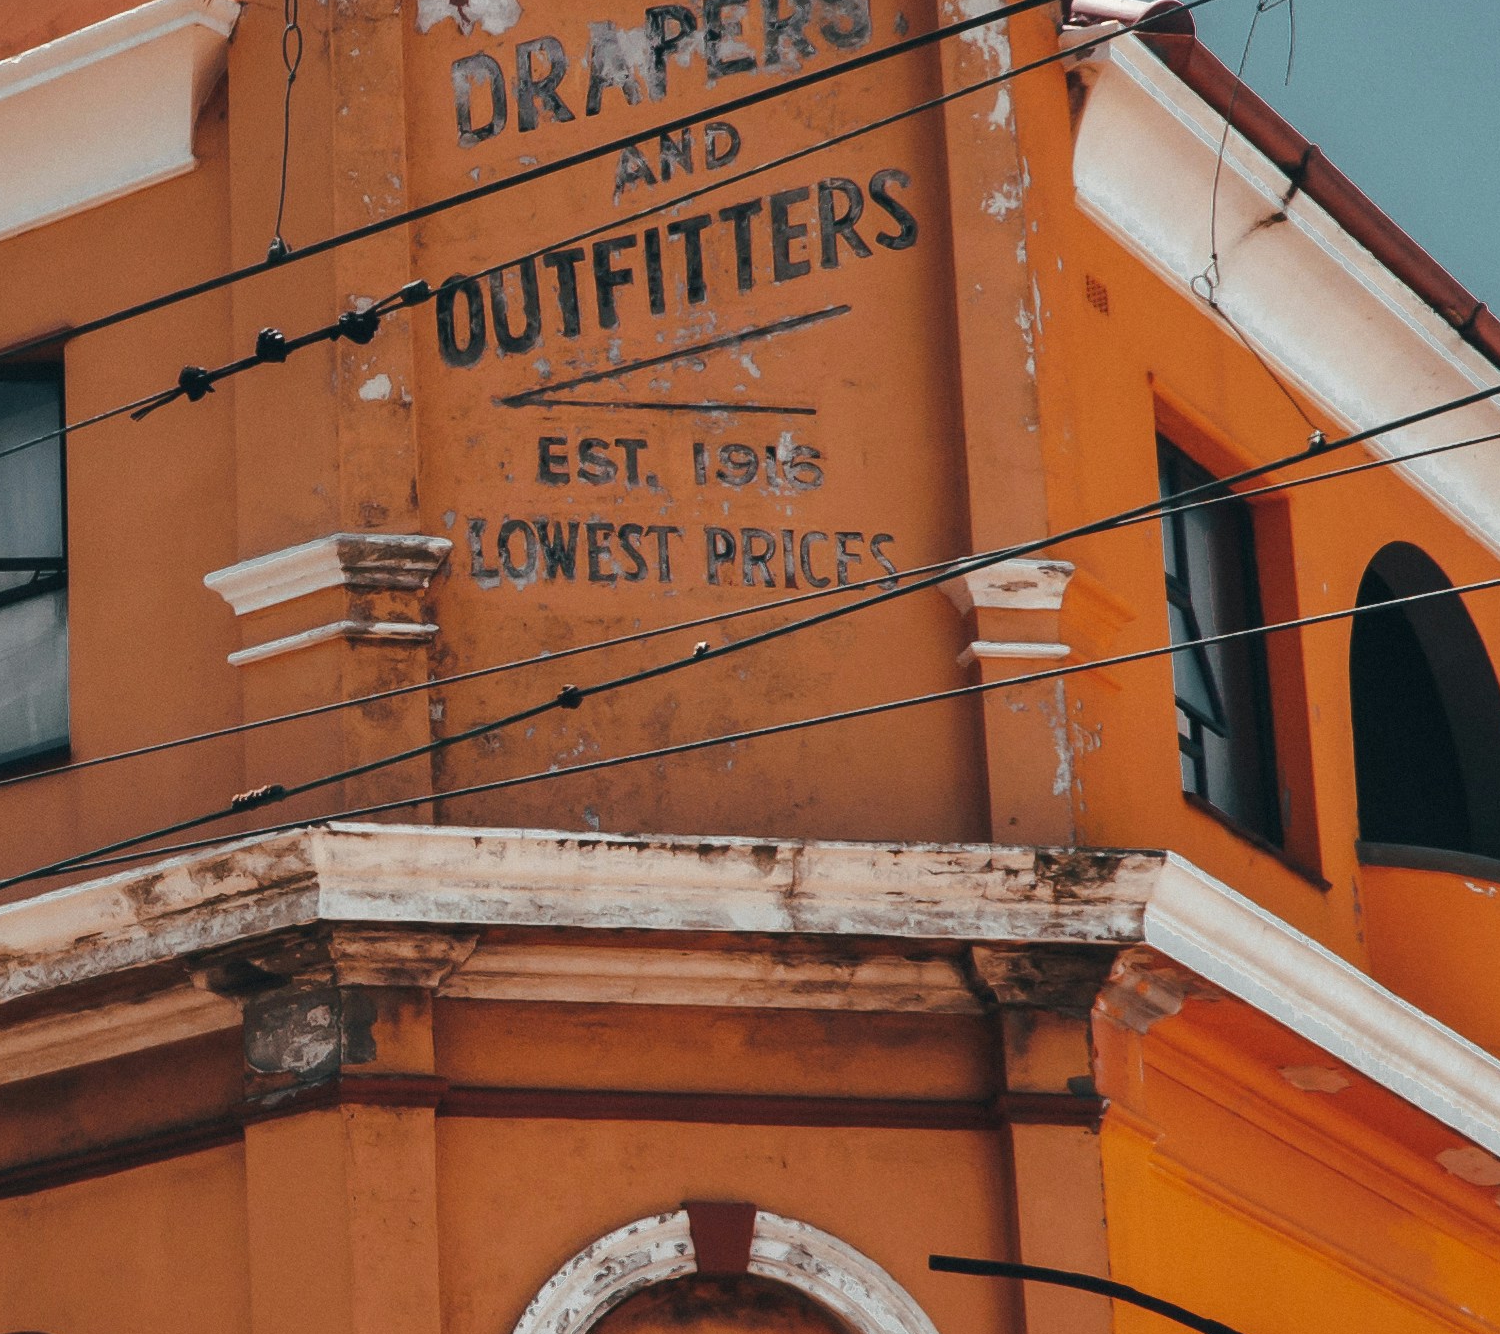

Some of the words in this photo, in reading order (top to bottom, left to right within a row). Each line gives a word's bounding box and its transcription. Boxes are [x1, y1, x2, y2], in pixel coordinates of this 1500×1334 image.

[613, 121, 742, 208] AND
[435, 168, 920, 367] OUTFITTERS
[467, 518, 684, 589] LOWEST
[703, 525, 900, 590] PRICES
